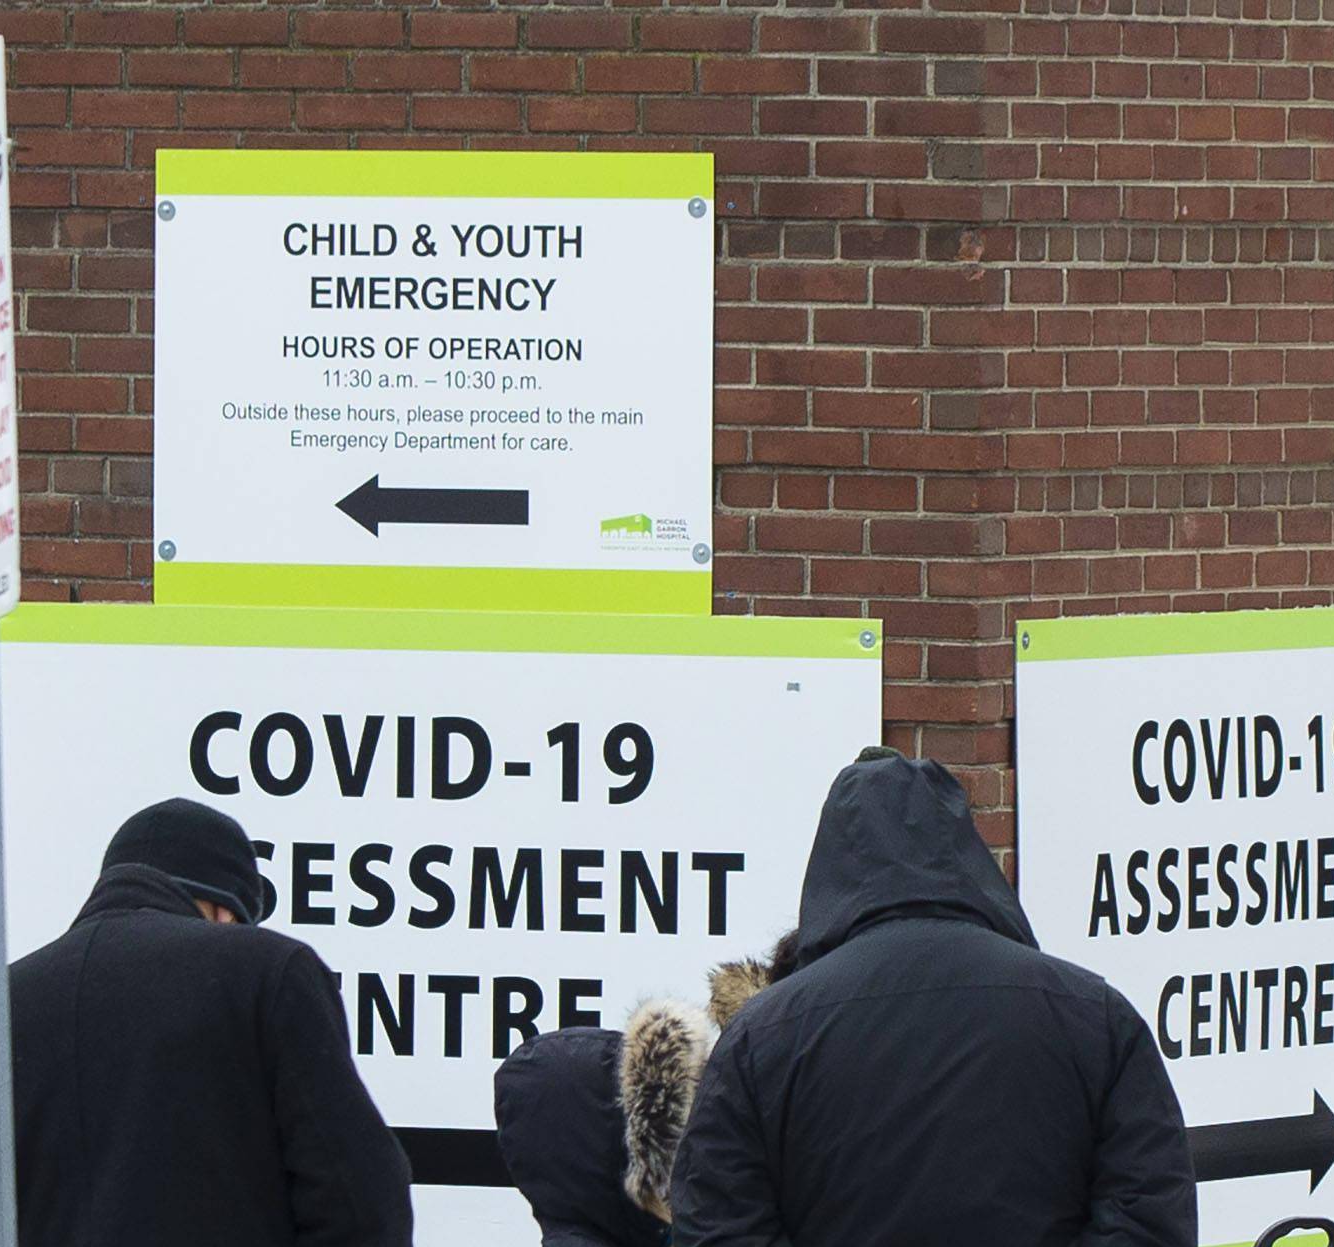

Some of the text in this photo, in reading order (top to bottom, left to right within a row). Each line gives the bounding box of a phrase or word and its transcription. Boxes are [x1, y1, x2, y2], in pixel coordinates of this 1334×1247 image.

[284, 223, 581, 258] CHILD & YOUTH
[311, 277, 556, 311] EMERGENCY
[284, 336, 581, 360] HOURS OF OPERATION
[324, 369, 371, 387] 11:30
[378, 374, 418, 388] a.m.
[445, 371, 495, 389] 10:30
[502, 375, 542, 394] p.m.
[223, 403, 643, 426] Outside these hours, please proceed to the main
[291, 430, 573, 452] Emergency Department for care.
[190, 711, 654, 804] COVID-19
[334, 972, 604, 1060] NTRE
[1158, 962, 1334, 1060] CENTRE
